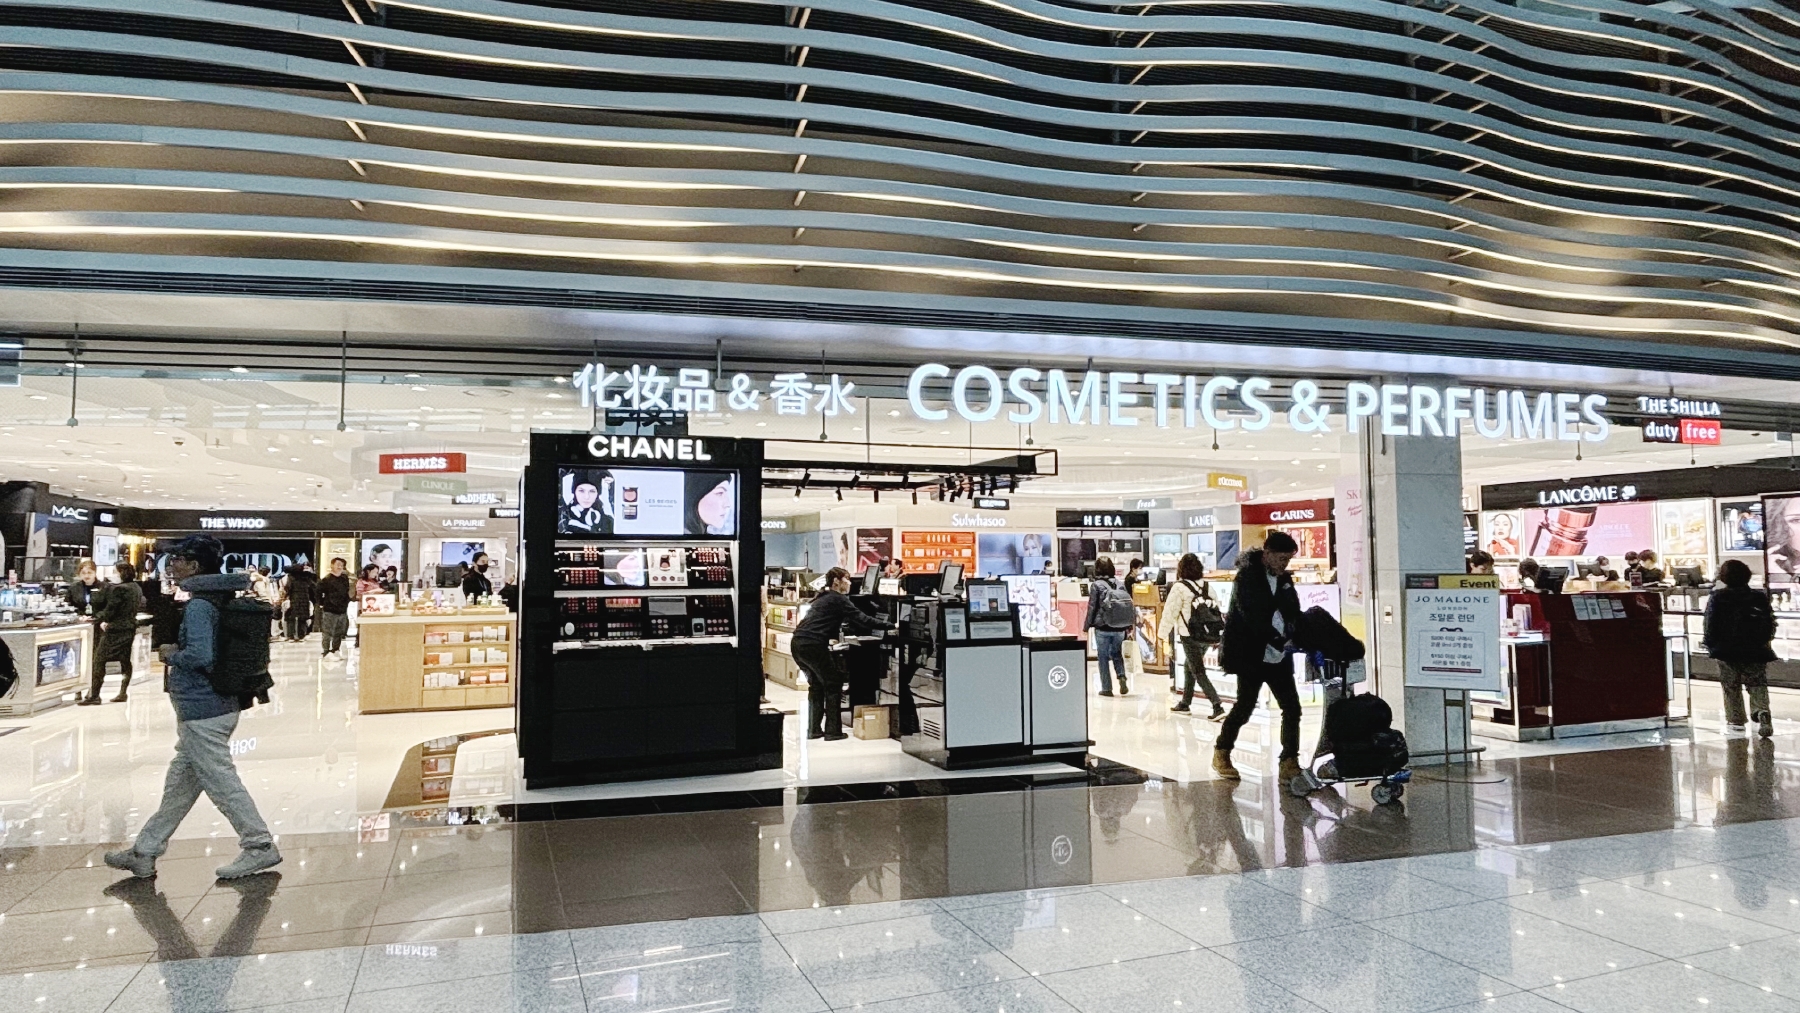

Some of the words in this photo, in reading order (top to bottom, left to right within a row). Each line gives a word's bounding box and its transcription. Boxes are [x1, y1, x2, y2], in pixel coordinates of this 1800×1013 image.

[572, 362, 716, 411] 化妆品
[728, 372, 760, 411] &
[769, 372, 857, 416] 香水
[907, 363, 1272, 431] COSMETICS
[1289, 380, 1332, 433] &
[1346, 382, 1610, 442] PERFUMES
[1638, 396, 1667, 414] THE
[1670, 397, 1721, 416] SHILLA
[1646, 421, 1679, 442] duty
[1686, 423, 1717, 440] free
[588, 435, 712, 461] CHANEL
[421, 480, 455, 490] CLINIQUE
[1539, 485, 1618, 504] LANCÔME
[1136, 499, 1156, 510] fresh
[52, 505, 89, 521] MAC
[1270, 508, 1315, 521] CLARINS
[199, 517, 225, 528] THE
[227, 518, 267, 529] WHOO
[442, 519, 452, 527] LA
[453, 519, 486, 527] PRAIRIE
[952, 513, 1007, 527] Sulwhasoo
[1083, 514, 1123, 526] HERA
[1460, 579, 1497, 589] Event
[1435, 596, 1490, 604] MALONE
[1429, 613, 1455, 622] 조말론
